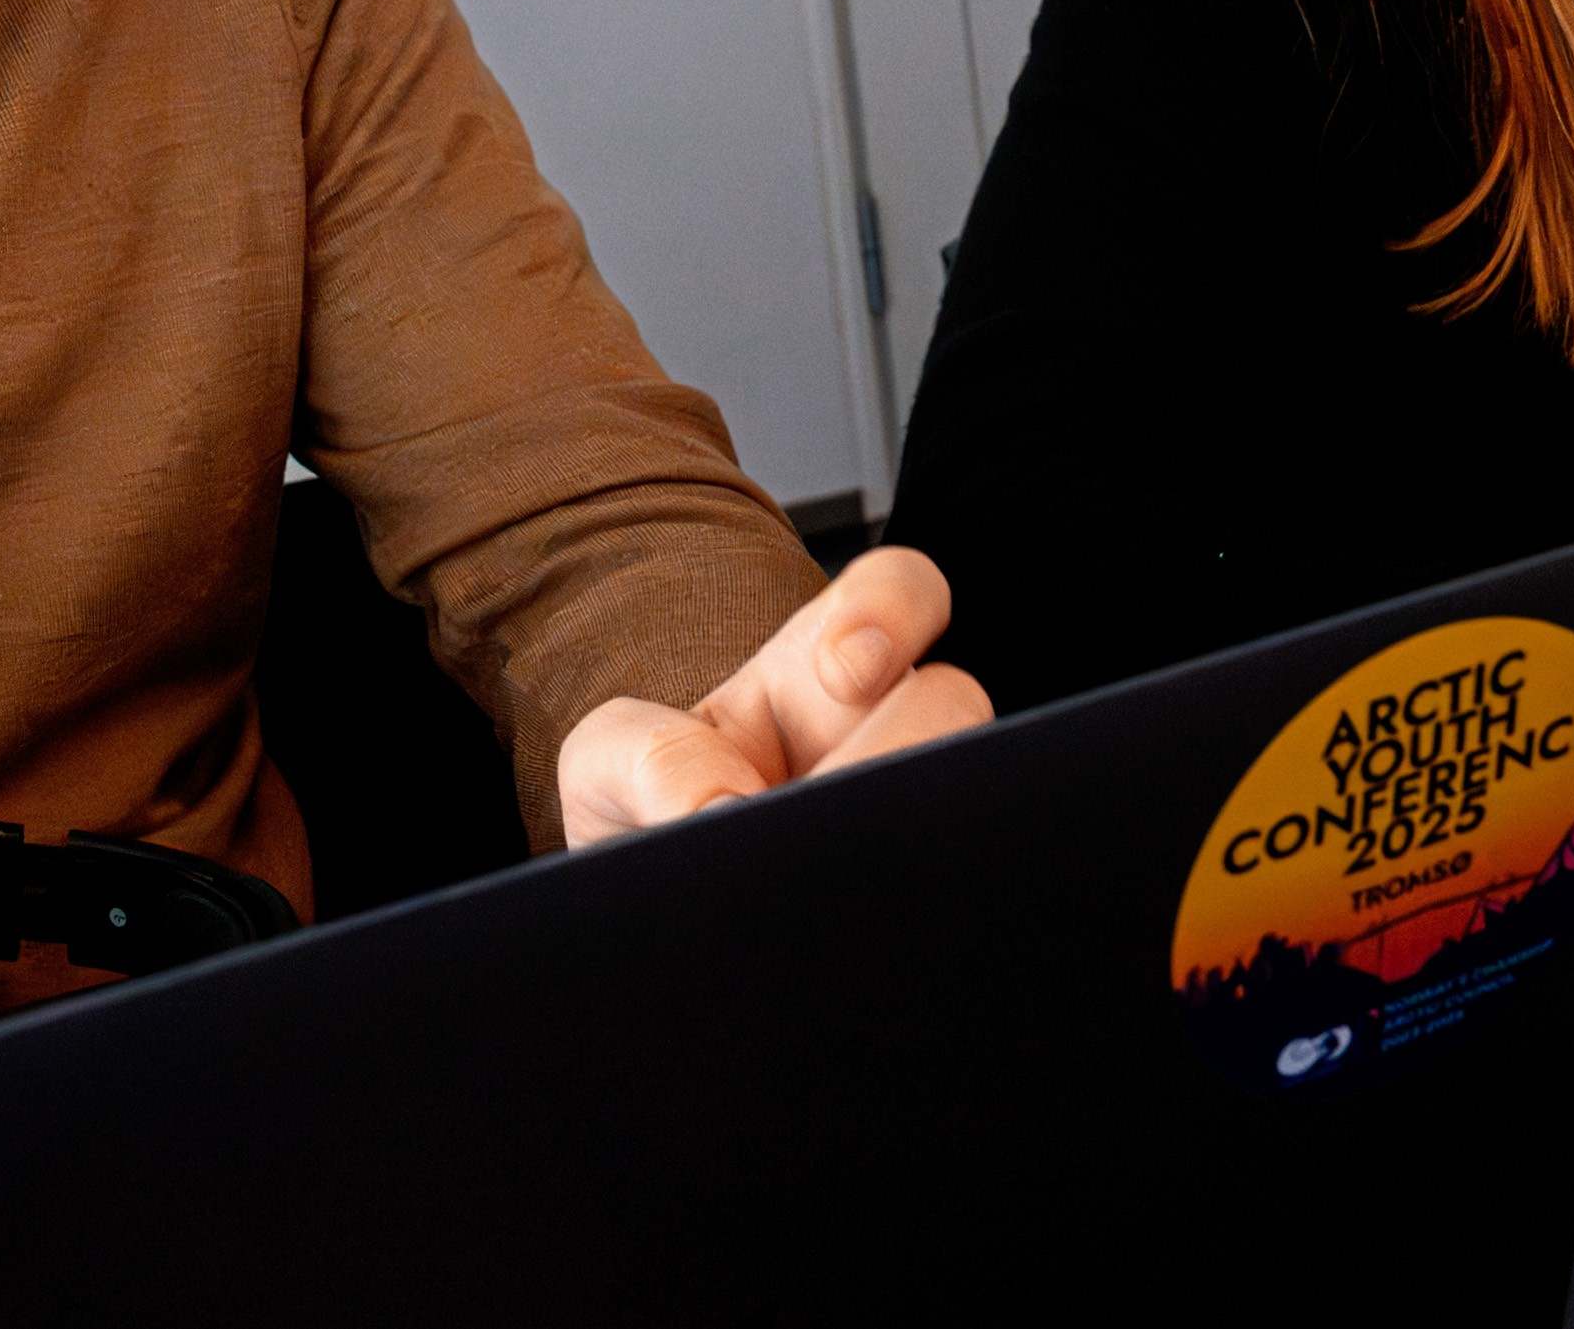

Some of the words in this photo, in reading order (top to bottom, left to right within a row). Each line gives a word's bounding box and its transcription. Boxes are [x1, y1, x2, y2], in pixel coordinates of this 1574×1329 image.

[1322, 650, 1527, 761] ARCTIC
[1325, 694, 1518, 796] YOUTH
[1344, 786, 1486, 877] 2025
[1350, 851, 1473, 912] TROMSØ
